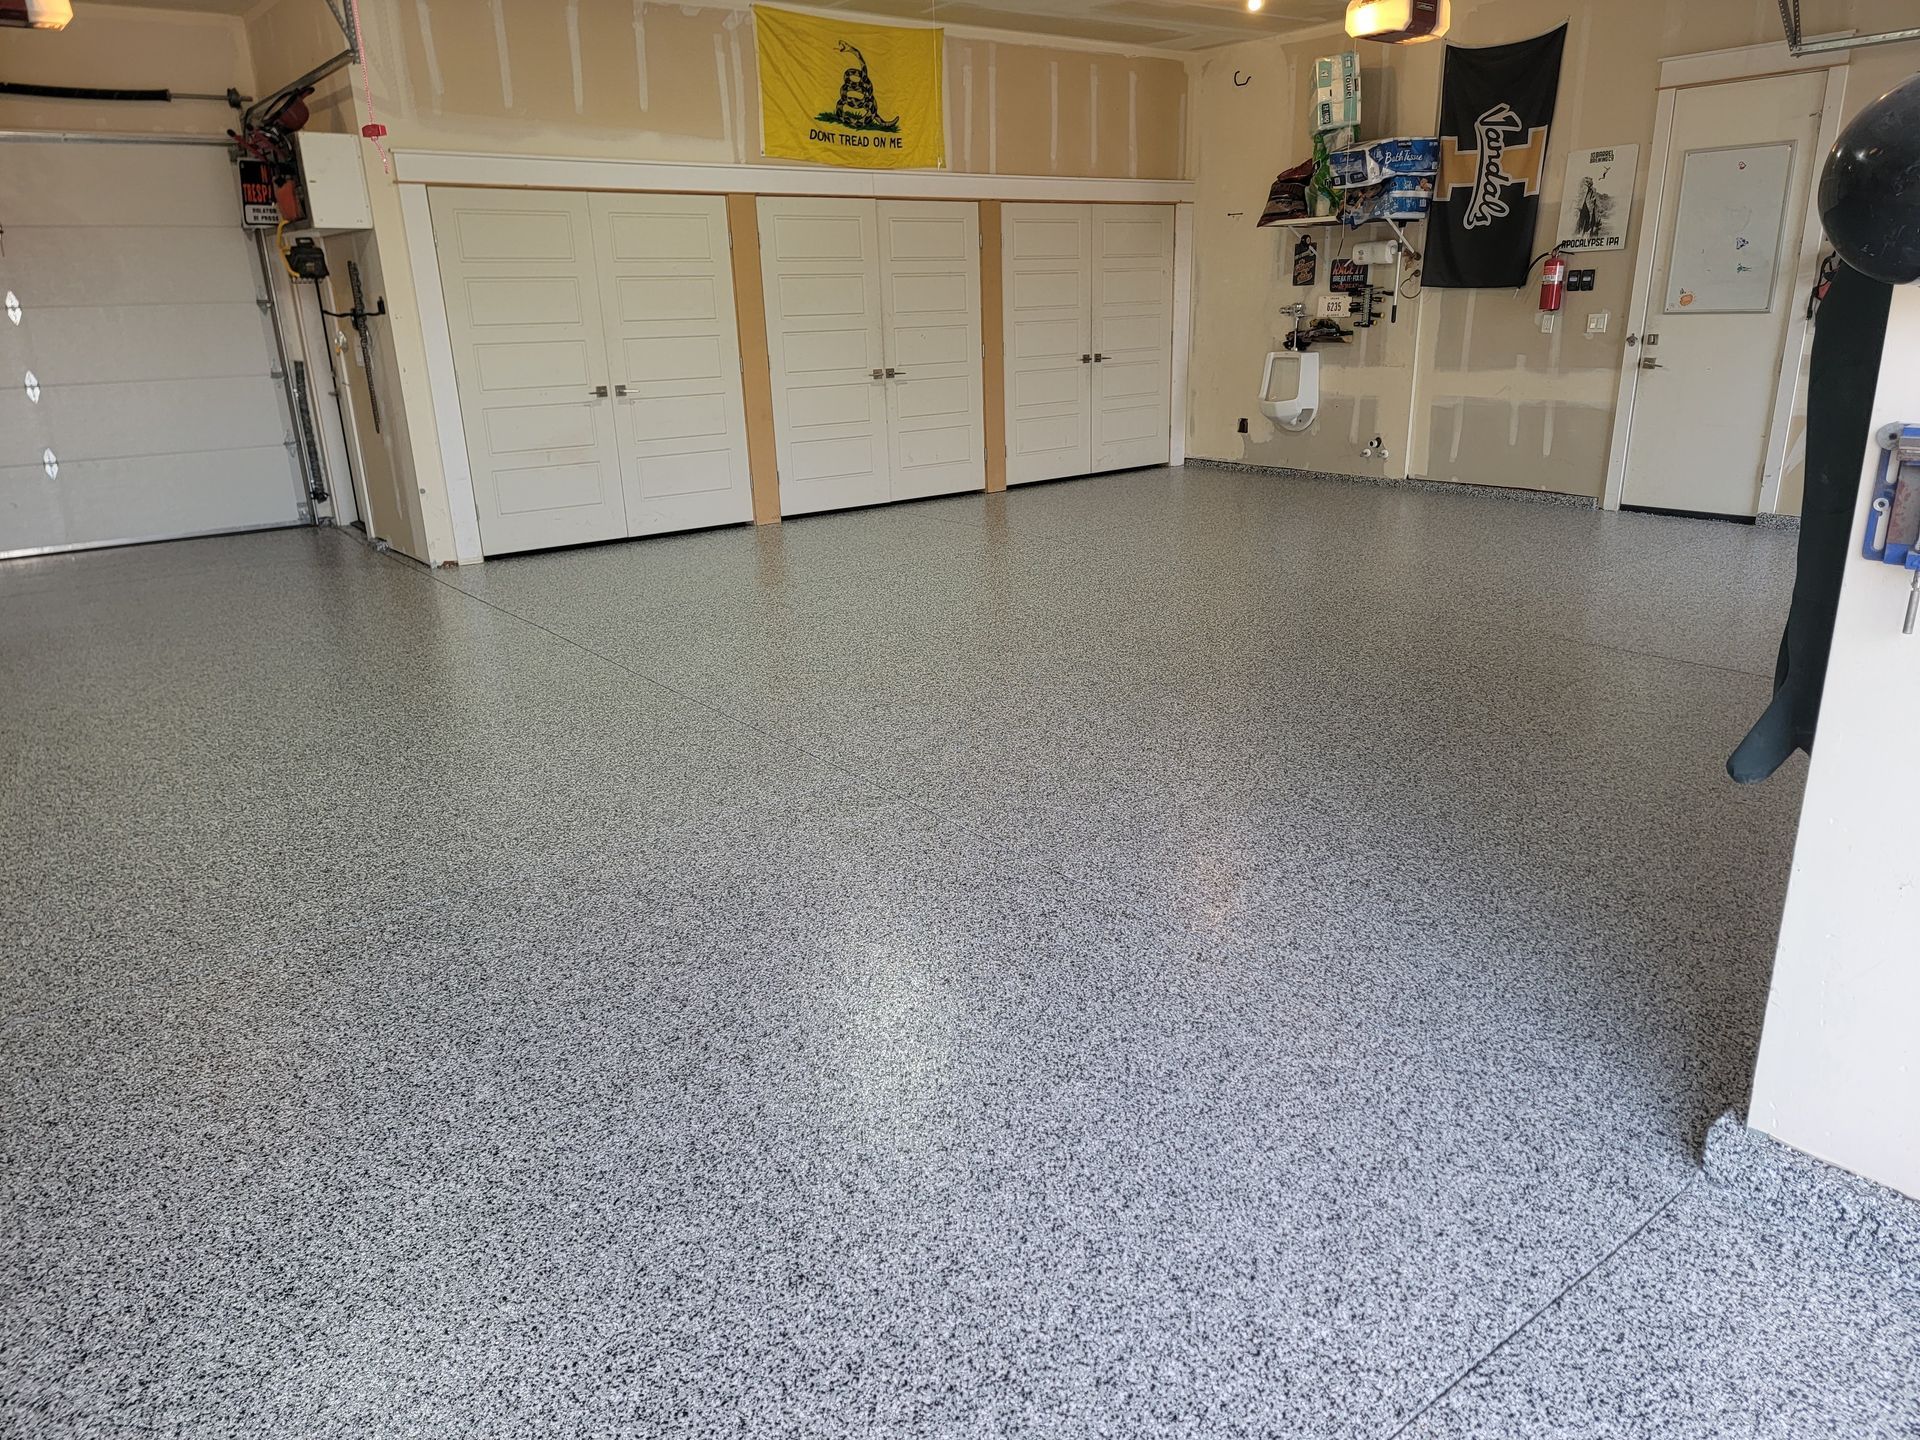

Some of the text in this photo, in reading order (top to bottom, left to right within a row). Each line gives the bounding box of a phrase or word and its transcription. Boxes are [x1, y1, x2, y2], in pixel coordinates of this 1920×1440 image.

[809, 129, 903, 148] DONT TREAD ON ME
[1385, 149, 1404, 164] Bath
[1403, 149, 1423, 161] Tissue
[1463, 103, 1522, 230] Vandals
[1561, 237, 1619, 249] APOCALYPSE IPA
[1326, 302, 1342, 312] 6235
